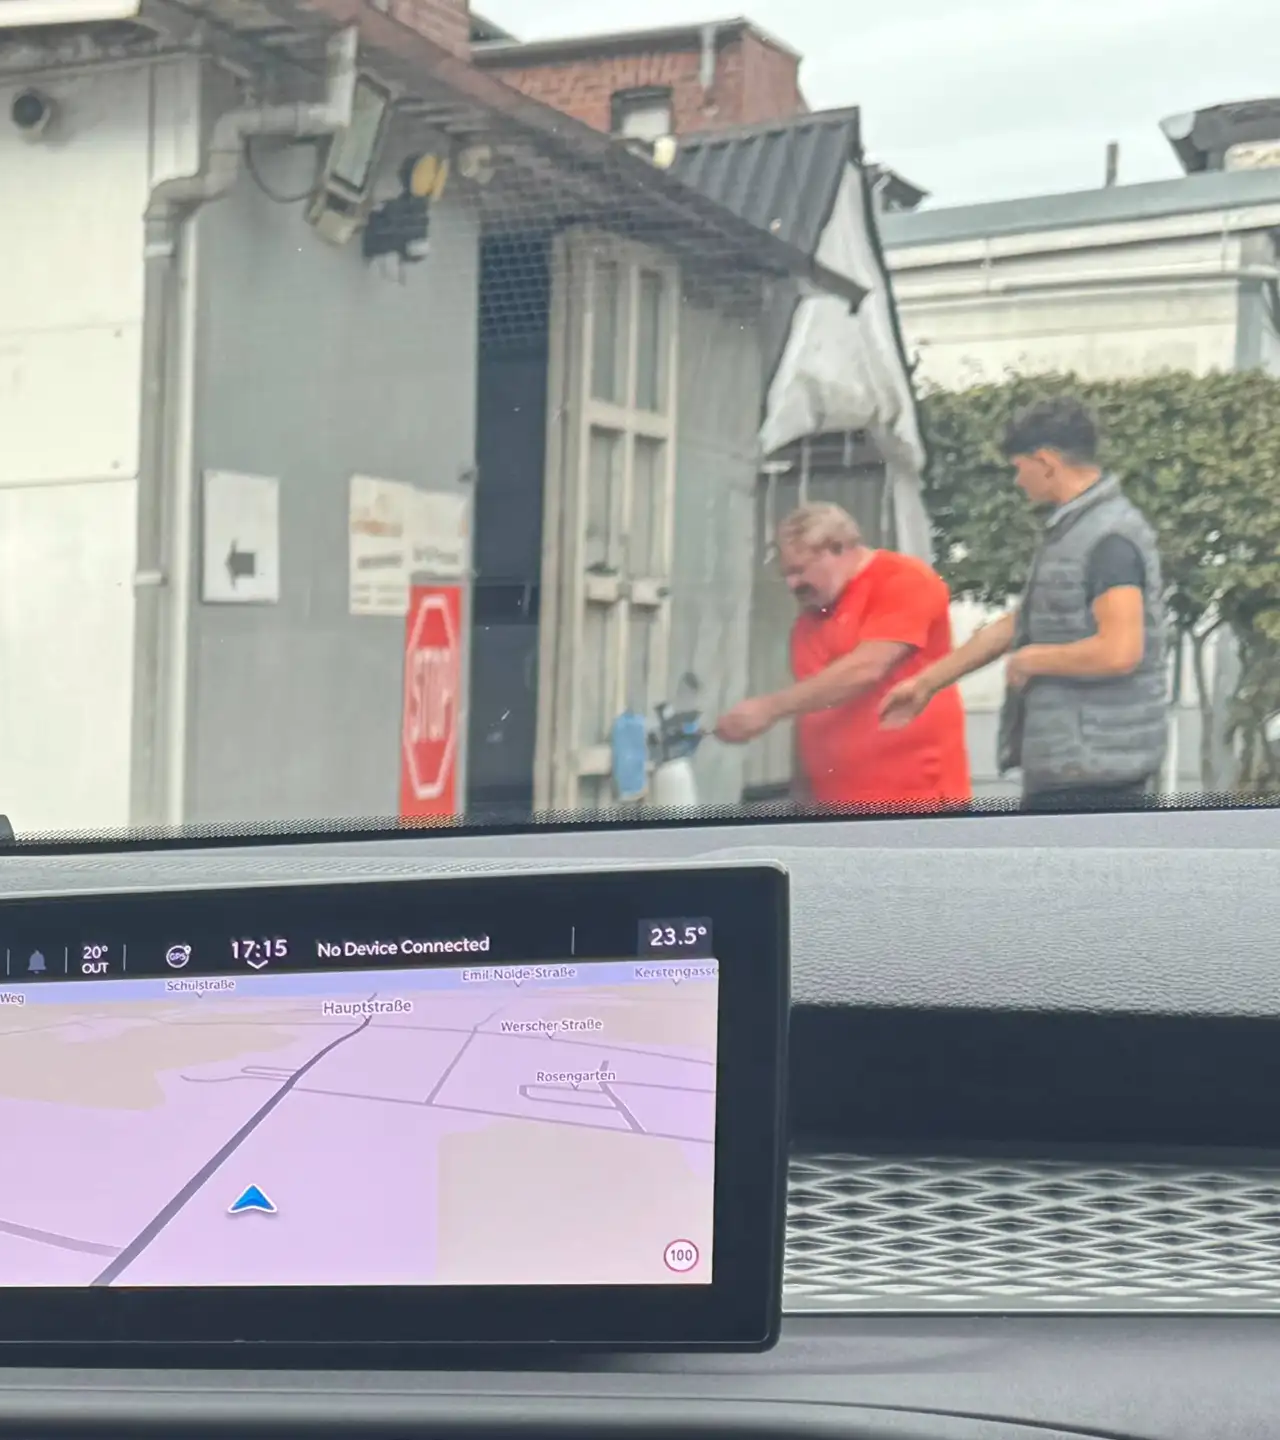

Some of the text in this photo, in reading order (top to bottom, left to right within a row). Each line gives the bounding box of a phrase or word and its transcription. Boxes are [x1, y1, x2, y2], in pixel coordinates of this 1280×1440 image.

[650, 926, 707, 946] 23.5°
[82, 945, 108, 960] 20°
[231, 939, 288, 959] 17:15
[317, 936, 490, 958] No Device Connected
[81, 962, 109, 974] OUT
[167, 980, 235, 991] Schulstraße
[0, 993, 25, 1006] Weg
[323, 999, 412, 1016] Hauptstraße
[501, 1018, 603, 1033] Werscher Straße
[536, 1069, 616, 1085] Rosengarten
[669, 1248, 694, 1263] 100
